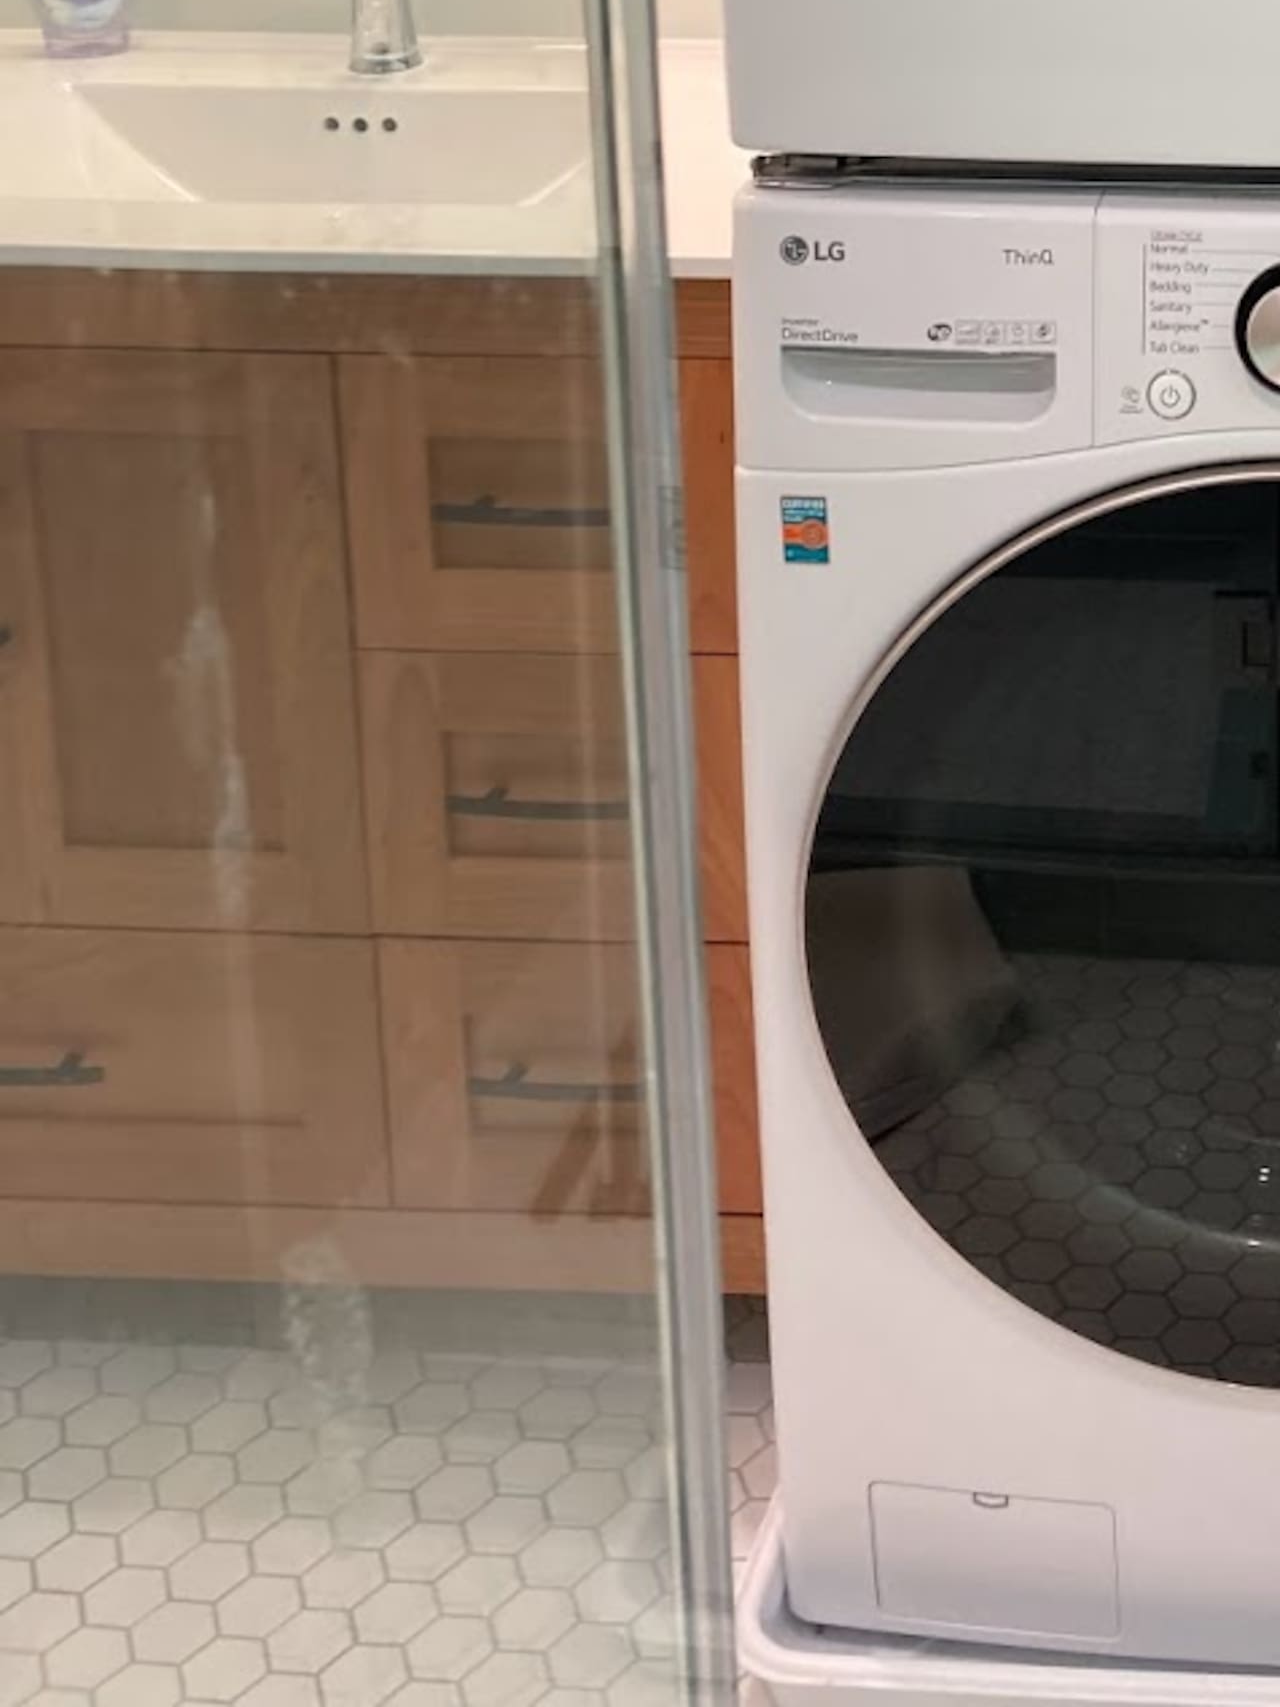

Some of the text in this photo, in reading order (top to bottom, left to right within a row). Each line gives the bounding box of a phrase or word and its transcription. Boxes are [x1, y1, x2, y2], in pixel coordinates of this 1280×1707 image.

[814, 241, 845, 262] LG
[1003, 249, 1054, 266] ThinQ
[1186, 261, 1209, 275] Duty
